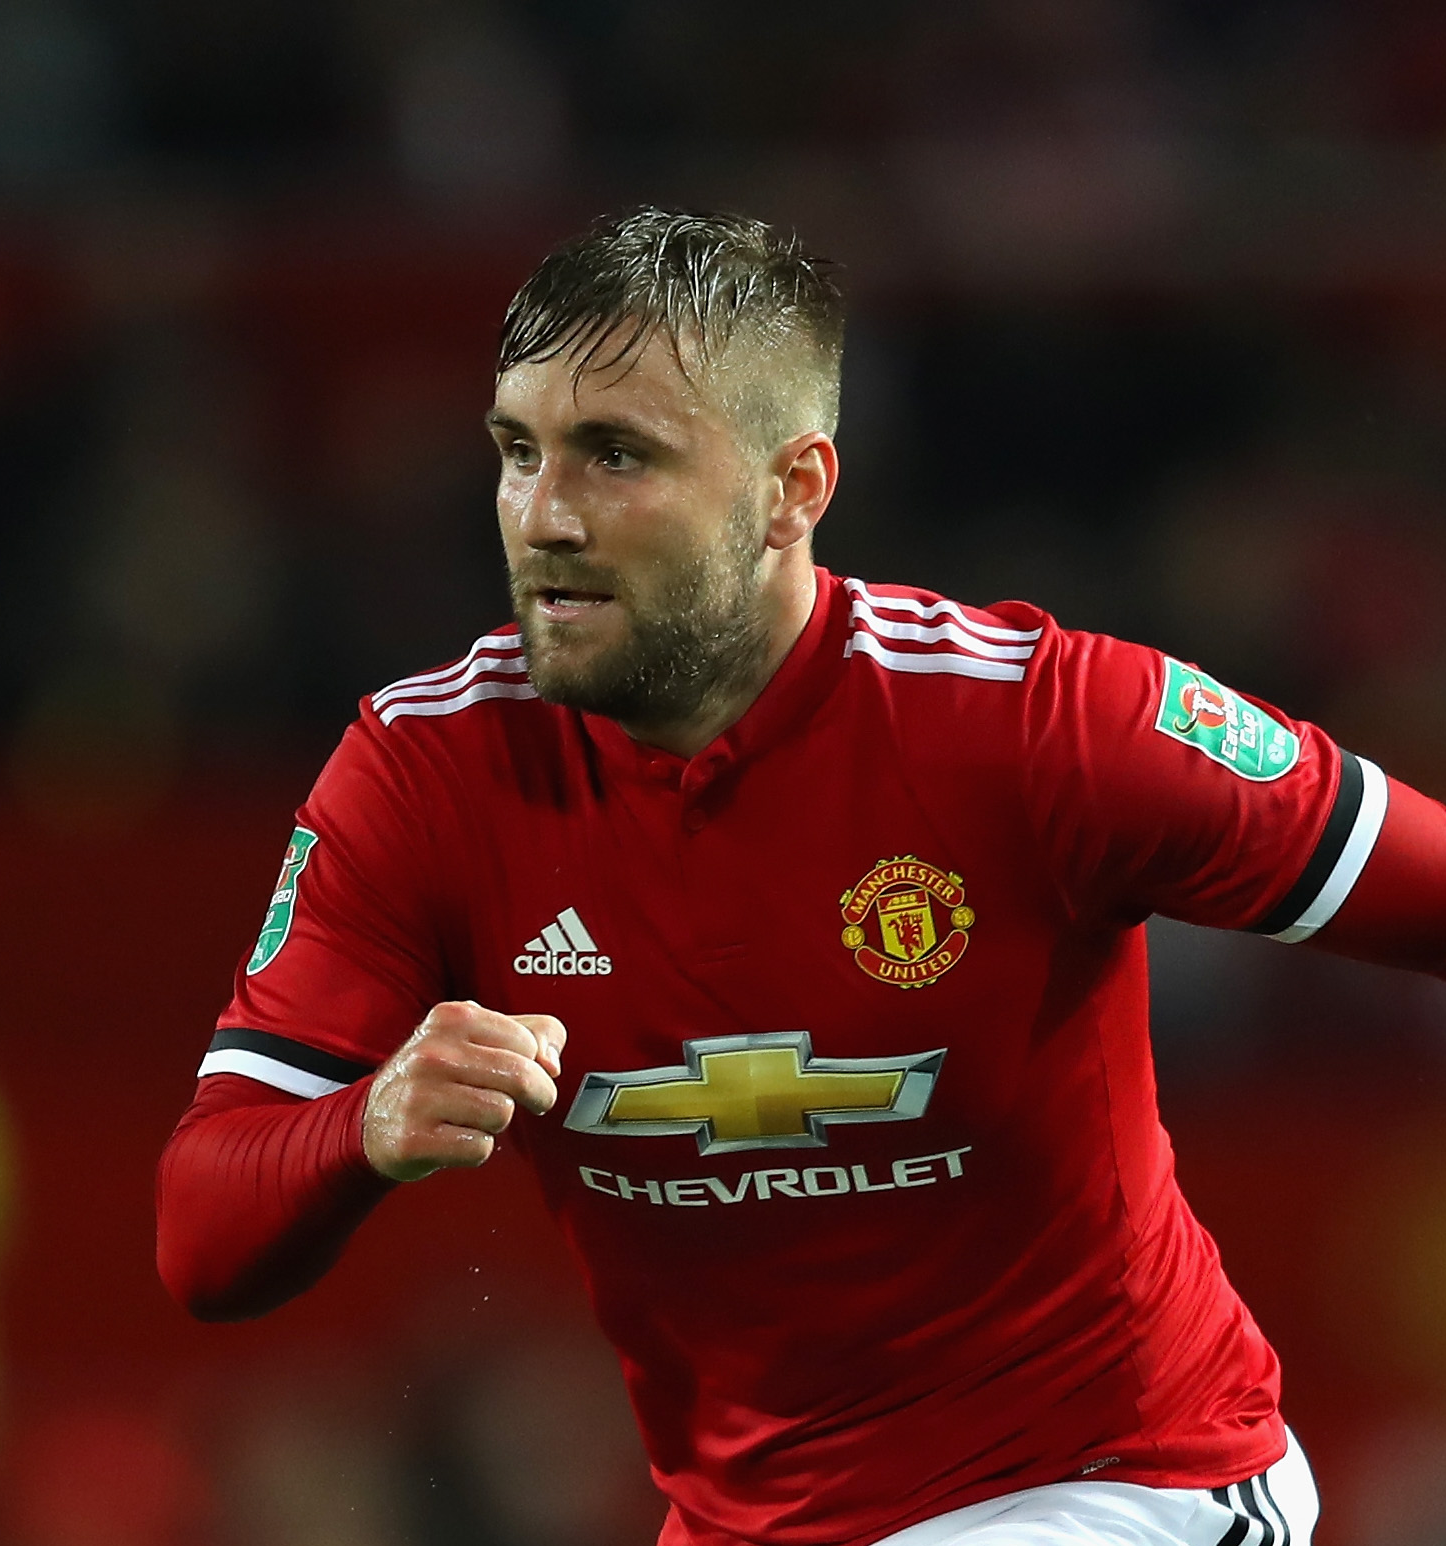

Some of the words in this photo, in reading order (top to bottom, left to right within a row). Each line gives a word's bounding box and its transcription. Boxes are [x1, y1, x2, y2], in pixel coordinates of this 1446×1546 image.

[1240, 711, 1258, 748] Cup
[851, 865, 955, 914] MANCHESTER
[514, 951, 612, 976] adidas
[879, 951, 952, 979] UNITED
[579, 1146, 972, 1206] CHEVROLET
